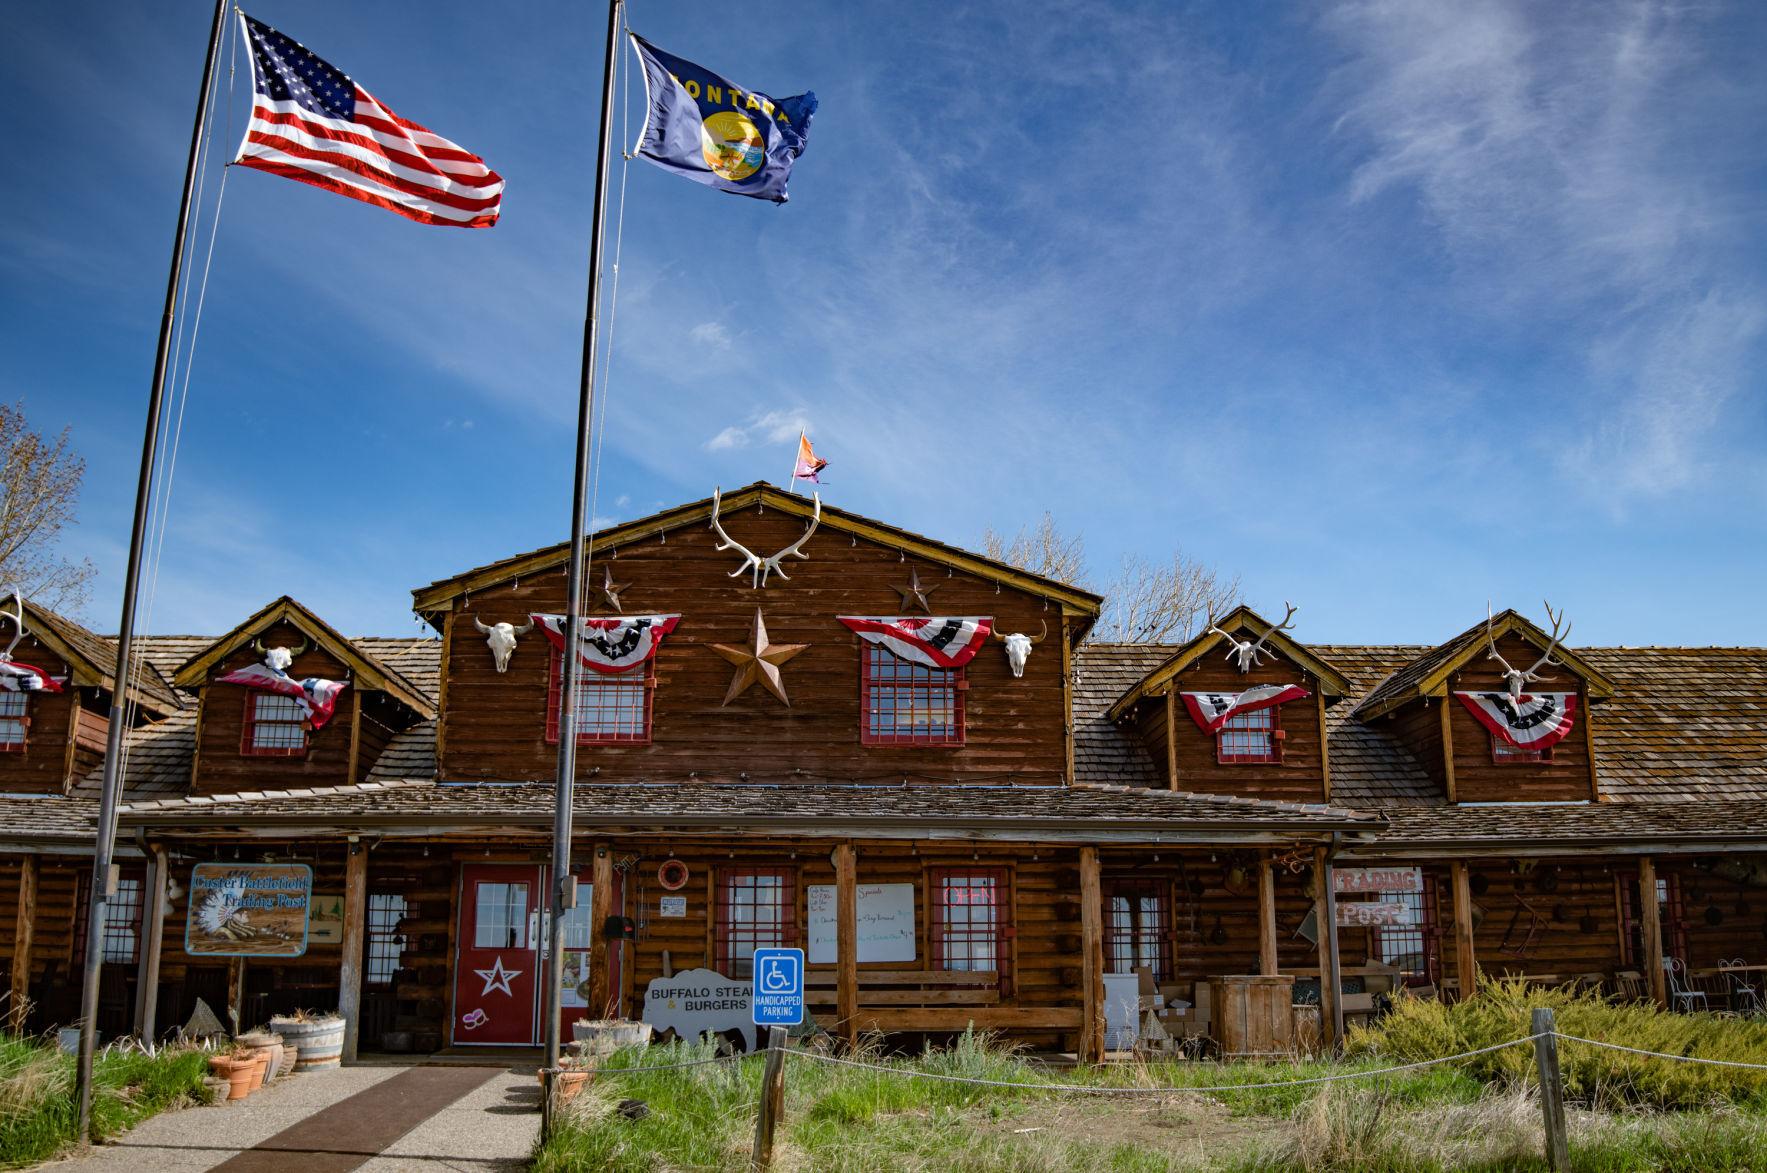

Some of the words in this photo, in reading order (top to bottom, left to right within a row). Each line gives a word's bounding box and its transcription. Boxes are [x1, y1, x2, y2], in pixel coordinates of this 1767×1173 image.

[672, 74, 792, 124] ONTANA
[194, 875, 236, 889] Custer
[240, 874, 307, 890] Battlefield
[1332, 870, 1416, 890] TRADING
[223, 893, 274, 910] Trading
[277, 893, 305, 908] Post
[944, 886, 996, 907] OPEN
[652, 988, 710, 999] BUFFALO
[755, 996, 801, 1006] HANDICAPPED
[667, 1000, 676, 1009] &
[685, 1000, 747, 1011] BURGERS
[763, 1006, 793, 1017] PARKING
